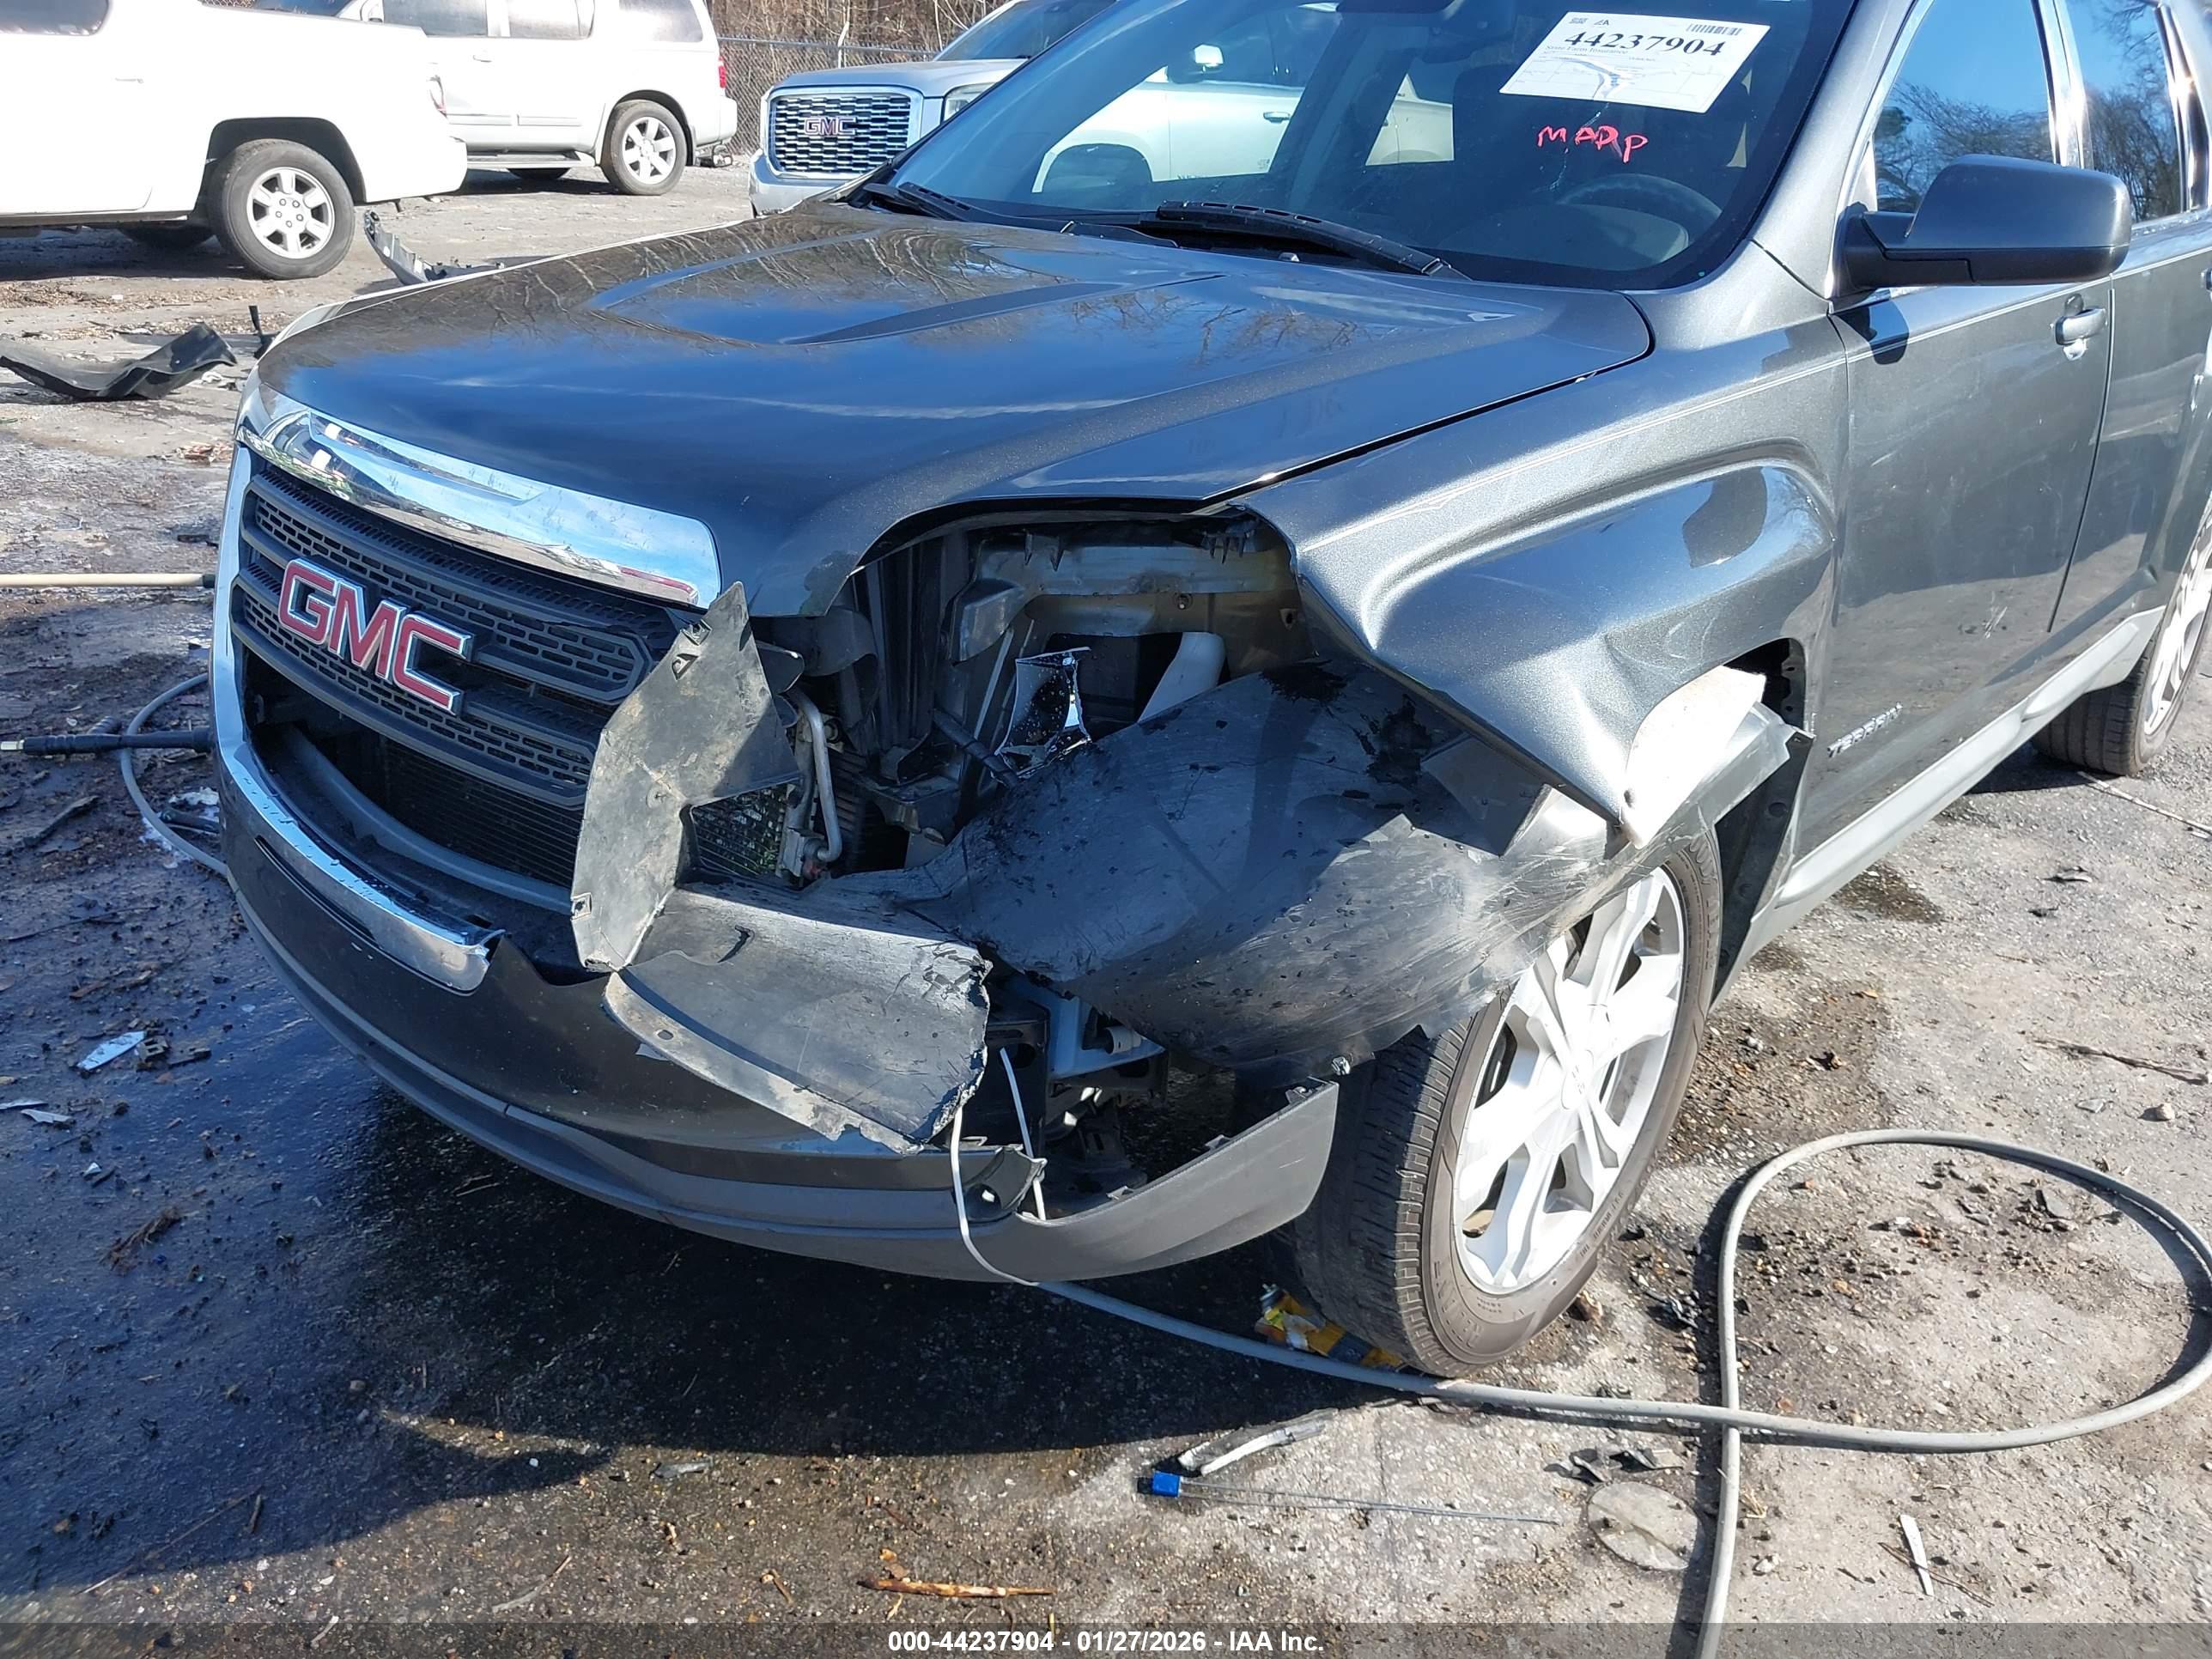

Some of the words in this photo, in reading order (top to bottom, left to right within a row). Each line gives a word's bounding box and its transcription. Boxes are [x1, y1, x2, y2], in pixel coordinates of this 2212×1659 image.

[1564, 30, 1727, 58] 44237904
[804, 116, 857, 136] GMC
[278, 557, 473, 716] GMC
